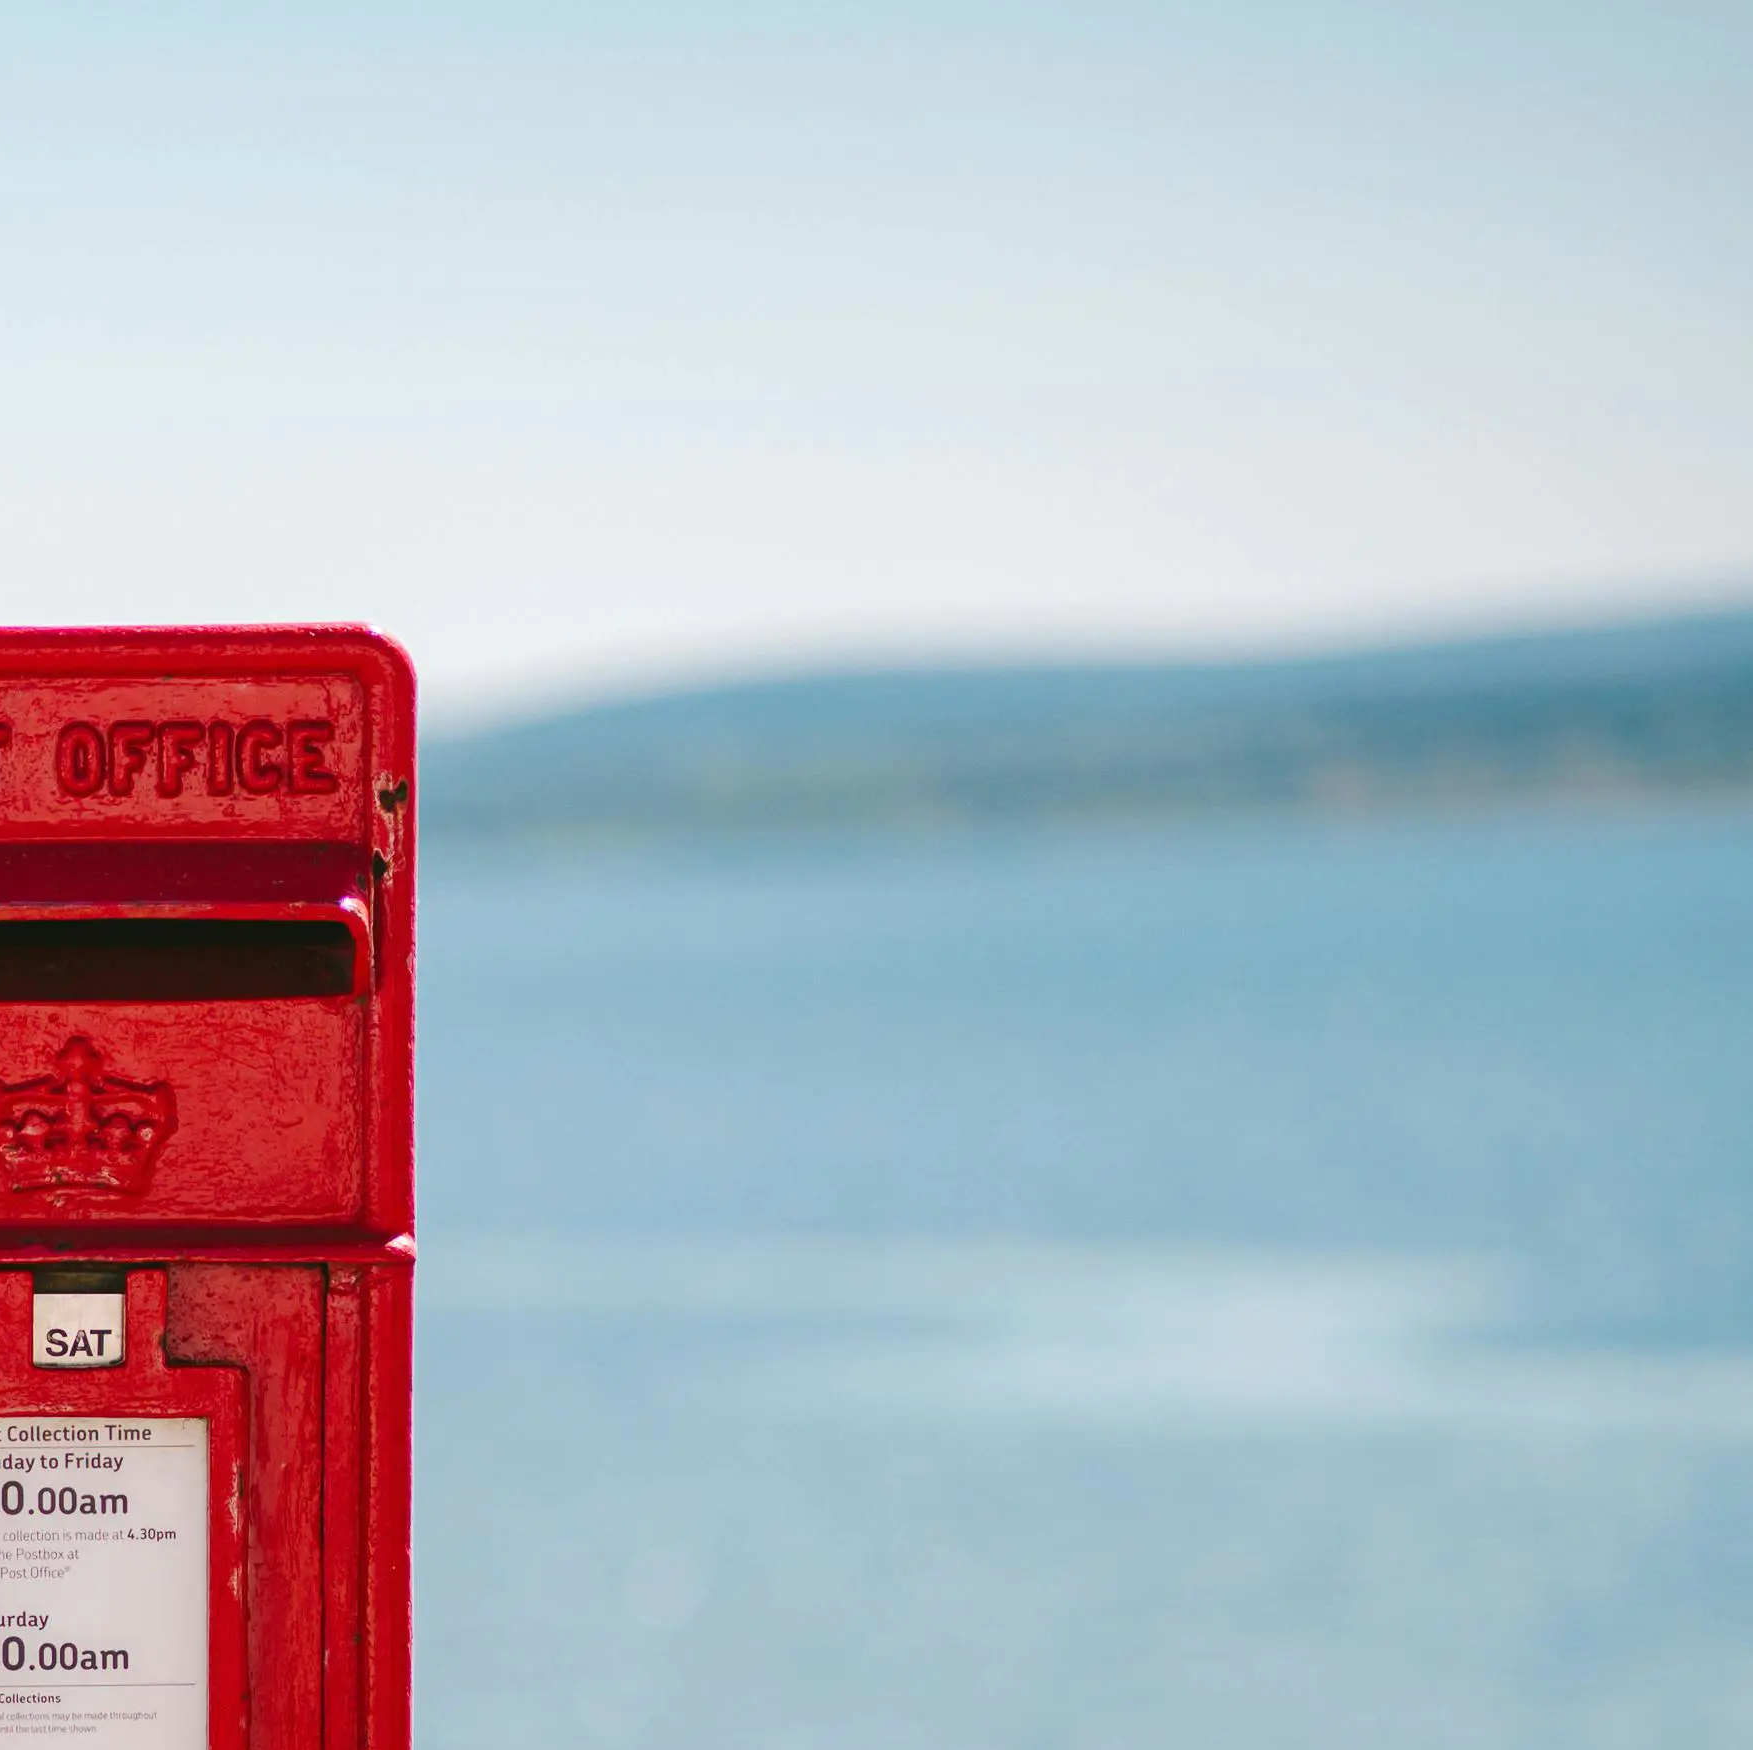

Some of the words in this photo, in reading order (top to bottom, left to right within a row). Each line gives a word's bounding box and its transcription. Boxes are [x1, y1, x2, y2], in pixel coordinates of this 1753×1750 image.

[55, 719, 339, 797] OFFICE
[45, 1329, 112, 1357] SAT
[8, 1425, 98, 1441] Collection
[104, 1425, 151, 1440] Time
[40, 1455, 58, 1469] to
[65, 1452, 123, 1472] Friday
[3, 1530, 59, 1541] collection
[62, 1529, 73, 1541] is
[75, 1529, 108, 1540] made
[112, 1530, 123, 1540] at
[127, 1528, 176, 1542] 4.30pm
[17, 1548, 64, 1560] Postbox
[67, 1549, 79, 1560] at
[1, 1567, 27, 1579] Post
[0, 1693, 61, 1704] Collections
